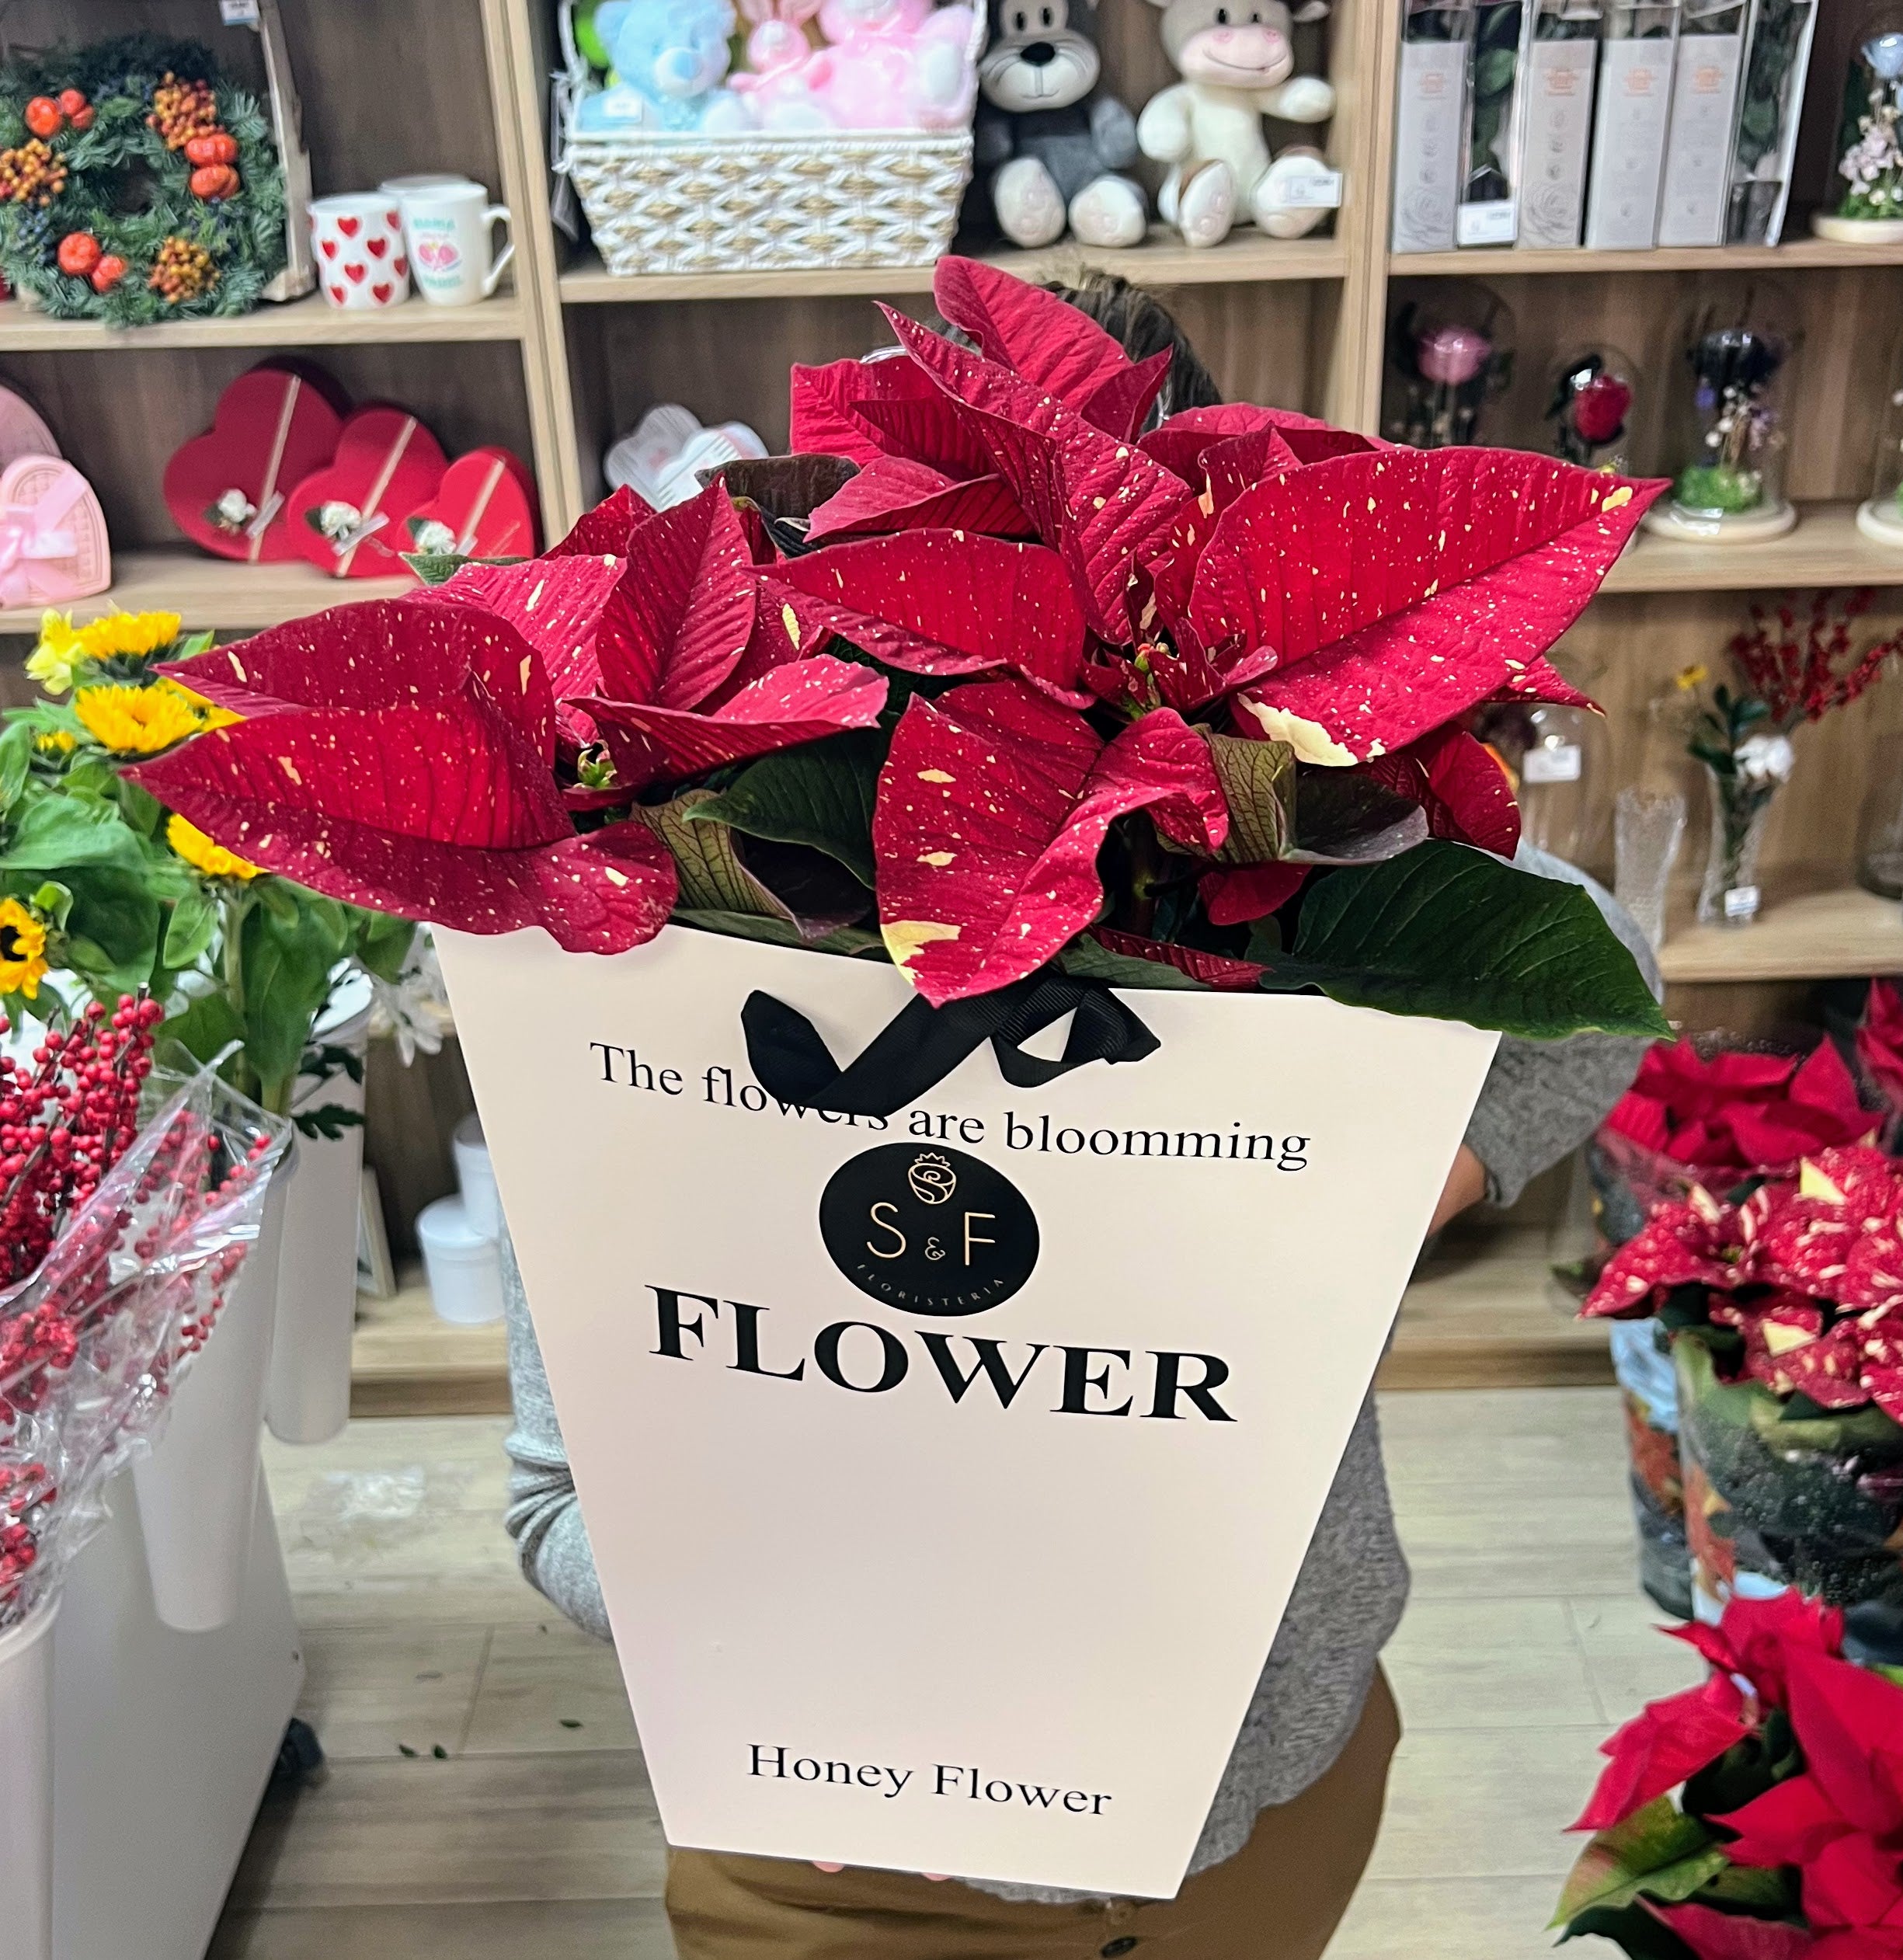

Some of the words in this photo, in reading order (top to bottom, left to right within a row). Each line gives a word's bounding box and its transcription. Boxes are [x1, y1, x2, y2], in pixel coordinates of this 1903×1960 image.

[589, 1041, 684, 1096] The
[907, 1109, 986, 1144] are
[1004, 1110, 1313, 1172] bloomming
[865, 1201, 907, 1259] S
[924, 1235, 947, 1262] &
[963, 1210, 997, 1267] F
[856, 1263, 1005, 1307] FLORISTERIA
[643, 1283, 1239, 1423] FLOWER
[746, 1743, 913, 1799] Honey
[931, 1763, 1114, 1816] Flower
